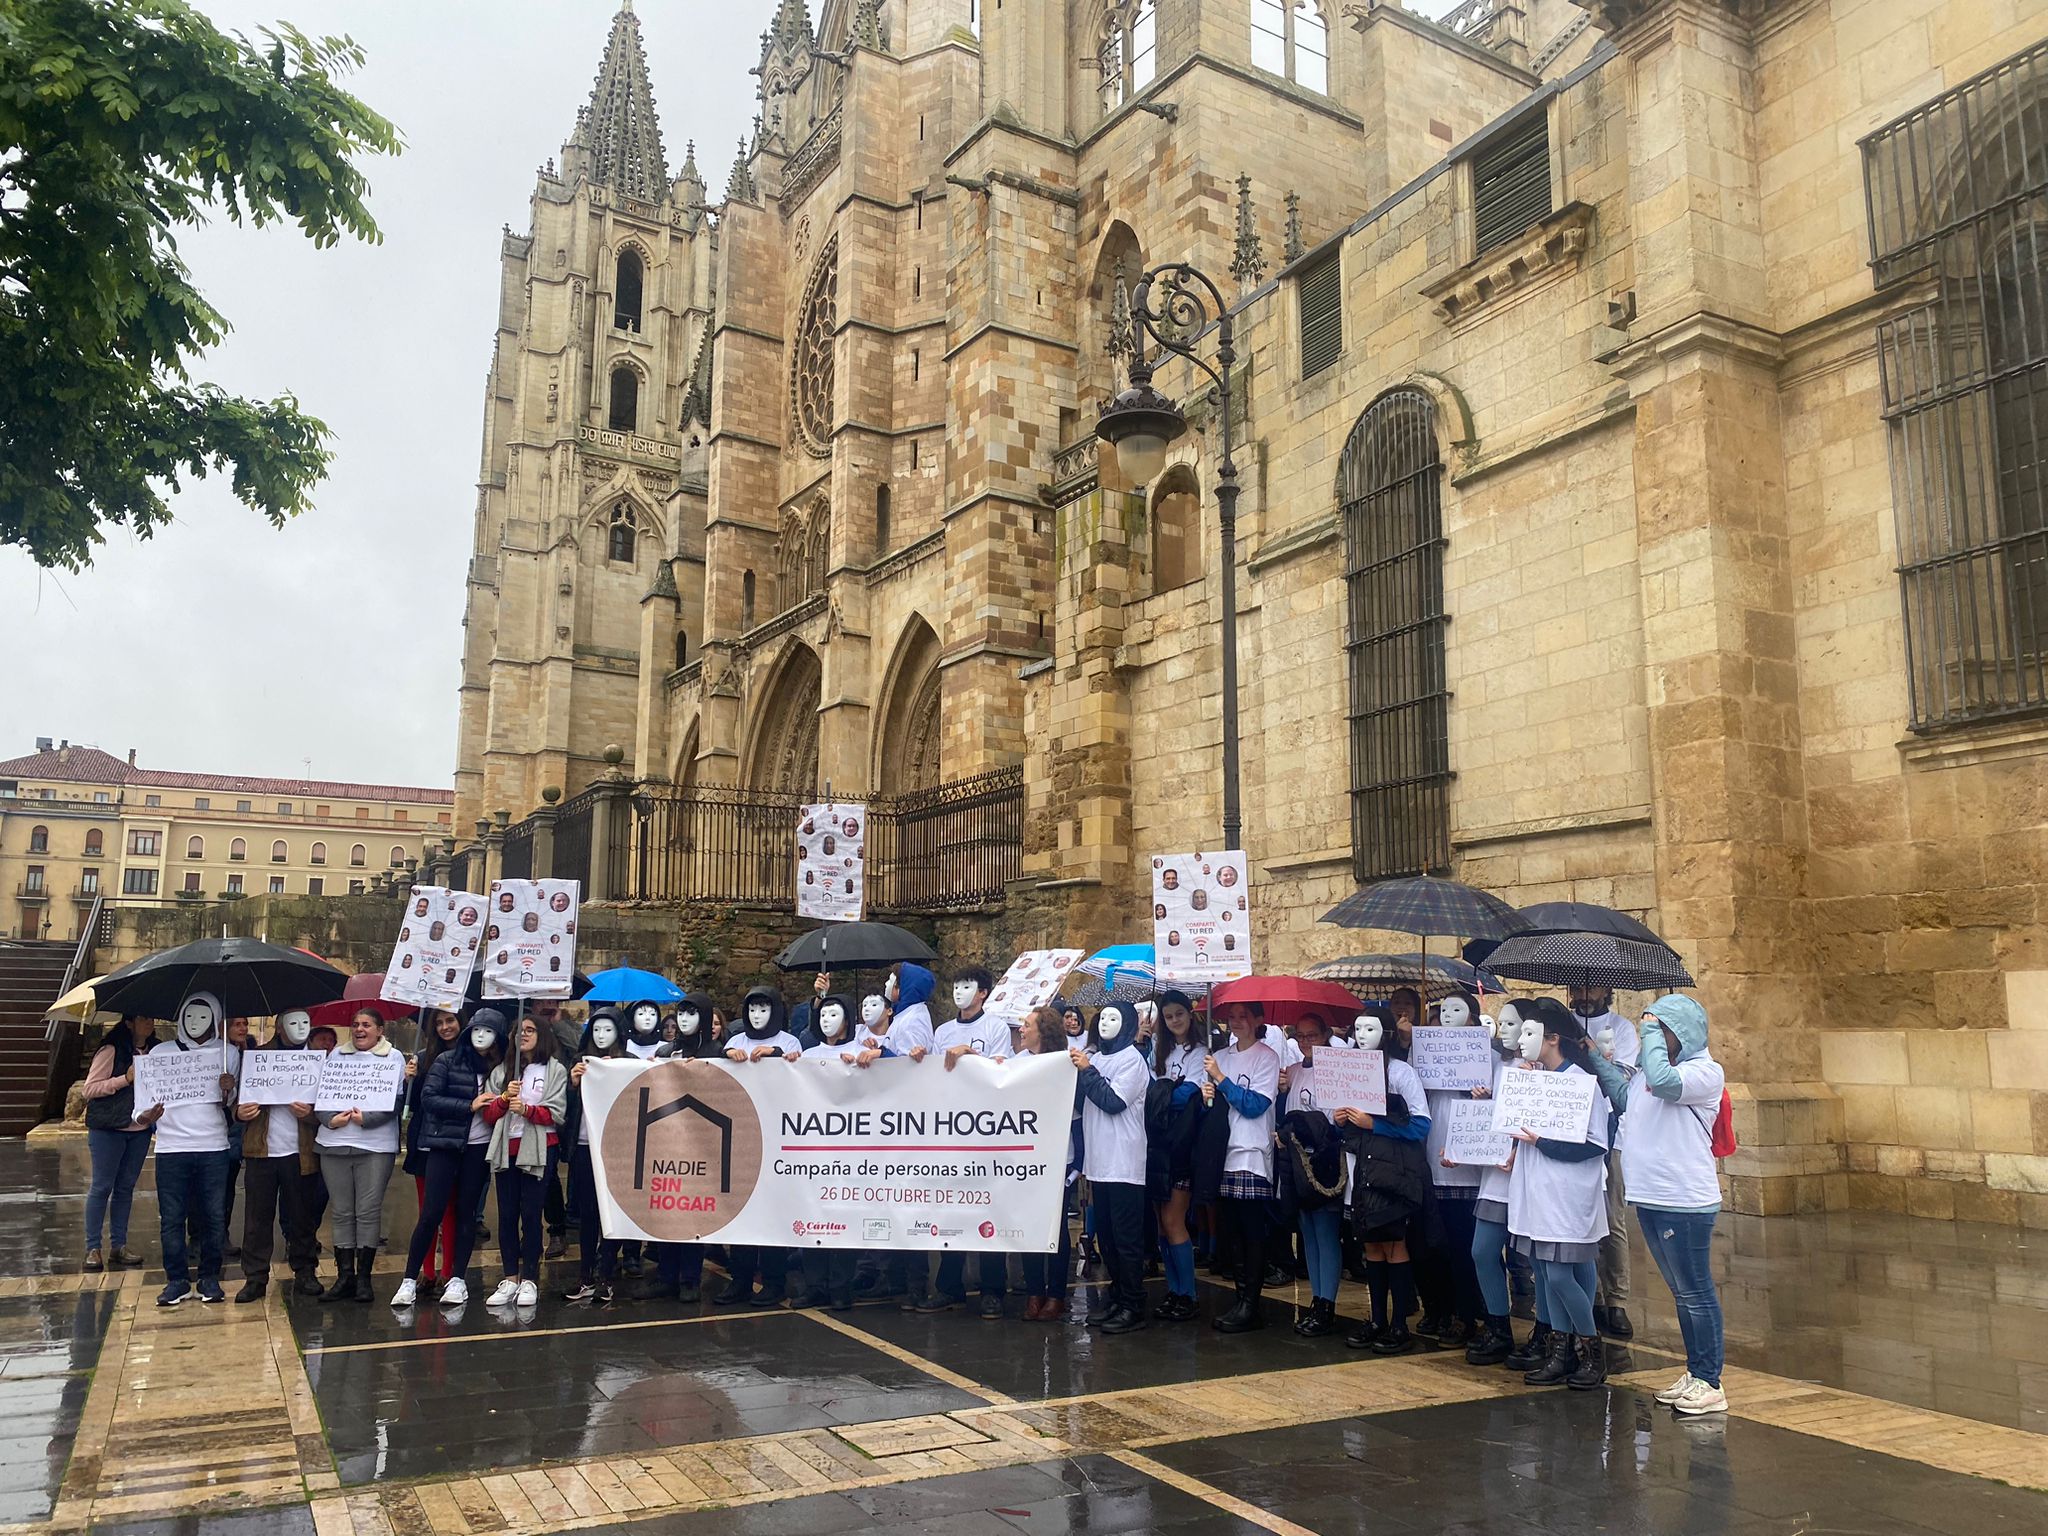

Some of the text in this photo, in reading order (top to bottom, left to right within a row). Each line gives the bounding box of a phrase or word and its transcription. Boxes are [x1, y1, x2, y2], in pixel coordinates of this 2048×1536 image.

[1422, 1042, 1483, 1052] VELEMOS POR
[142, 1055, 203, 1068] PASE LO QUE
[255, 1054, 268, 1063] EN
[275, 1054, 287, 1062] EL
[1417, 1053, 1489, 1065] EL BIENESTAR DE
[326, 1061, 343, 1069] TODA
[141, 1070, 157, 1079] PASE
[163, 1068, 181, 1077] TODO
[1342, 1072, 1369, 1083] NUNCA
[1414, 1066, 1457, 1078] TODOS SIN
[143, 1081, 154, 1090] YO
[170, 1077, 189, 1085] CEDO
[245, 1074, 317, 1088] SEAMOS RED
[1507, 1072, 1576, 1086] ENTRE TODOS
[332, 1092, 367, 1100] MUNDO
[1502, 1084, 1542, 1096] PODEMOS
[150, 1090, 206, 1103] AVANZANDO
[1456, 1103, 1467, 1117] LA
[1505, 1098, 1589, 1110] QUE SE RESPETEN
[1519, 1108, 1574, 1119] TODOS LOS
[781, 1110, 1039, 1136] NADIE SIN HOGAR
[1452, 1122, 1462, 1133] ES
[1465, 1121, 1474, 1132] EL
[1503, 1117, 1574, 1130] DERECHOS
[1489, 1135, 1498, 1144] DE
[652, 1159, 707, 1176] NADIE
[774, 1158, 1047, 1180] Campaña de personas sin hogar
[651, 1177, 682, 1192] SIN
[820, 1186, 992, 1205] 26 DE OCTUBRE DE 2023
[649, 1195, 716, 1212] HOGAR
[806, 1221, 847, 1230] Cáritas
